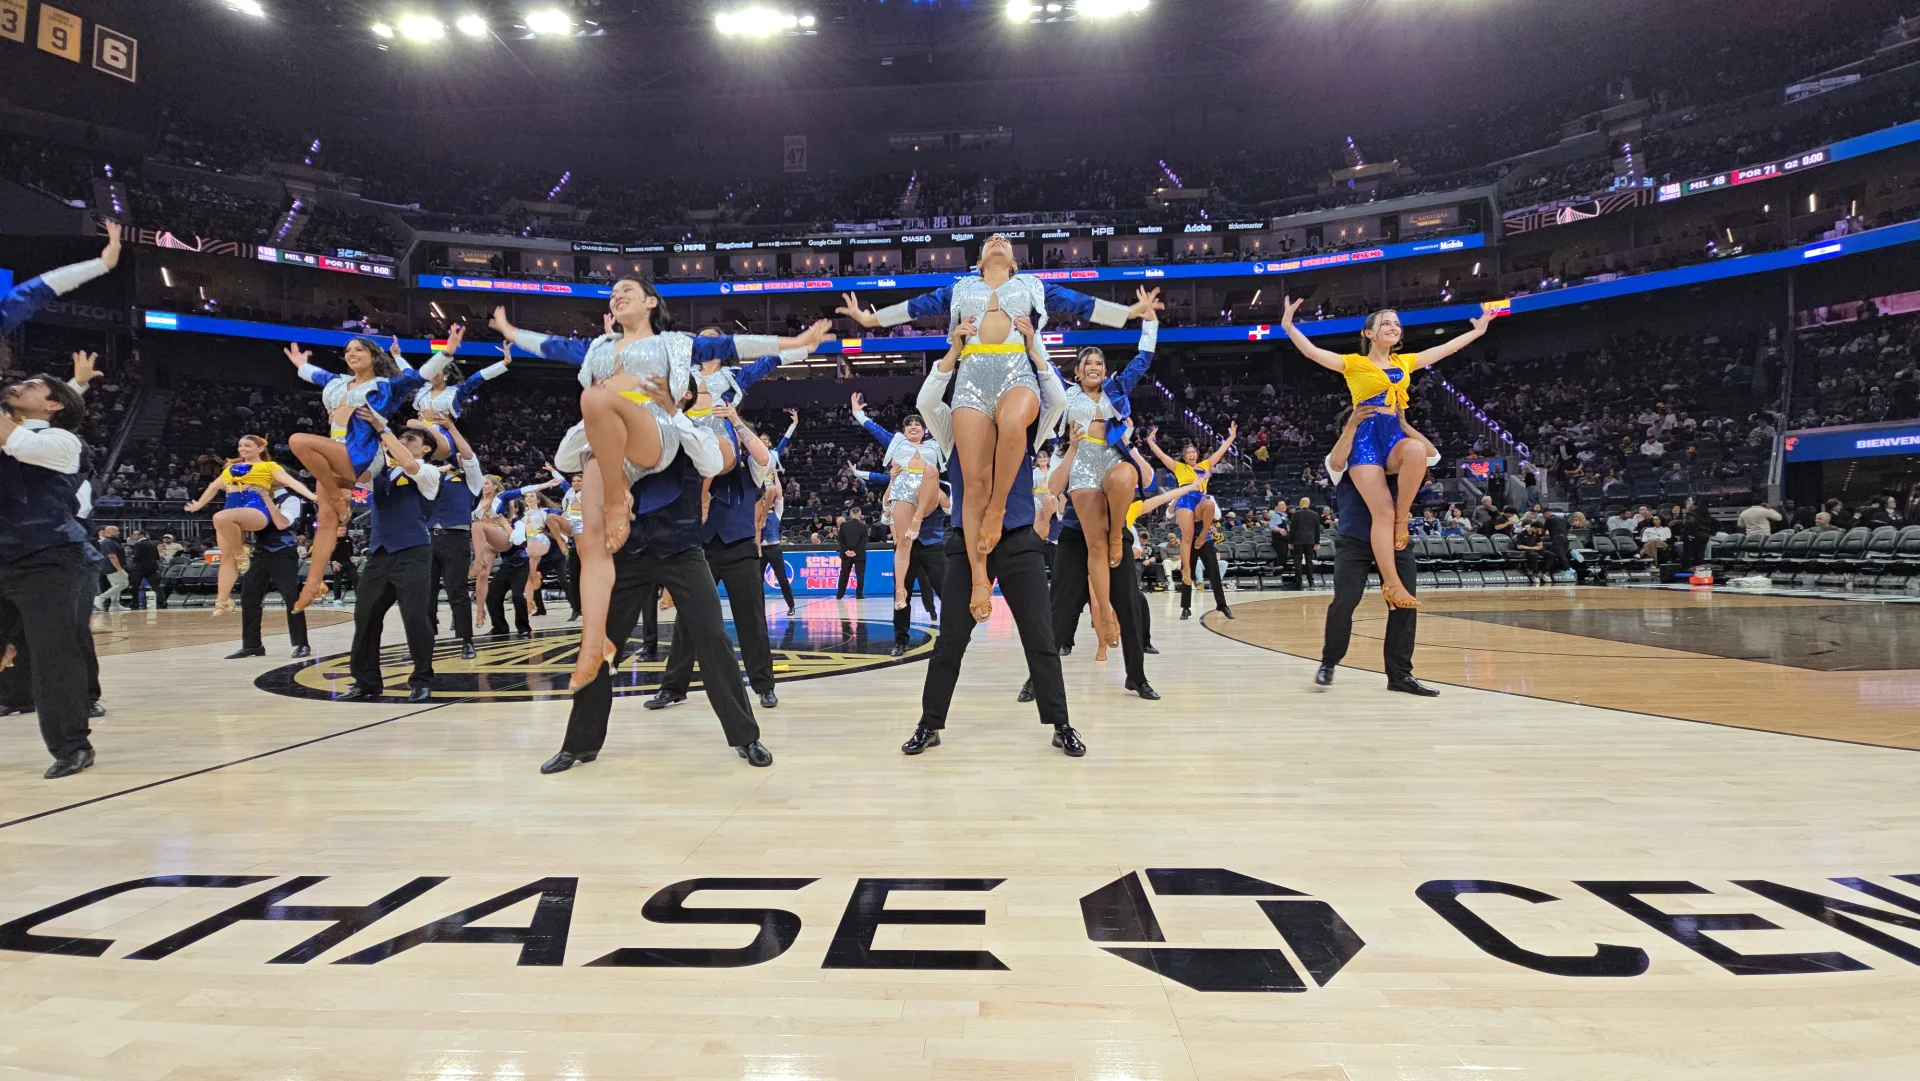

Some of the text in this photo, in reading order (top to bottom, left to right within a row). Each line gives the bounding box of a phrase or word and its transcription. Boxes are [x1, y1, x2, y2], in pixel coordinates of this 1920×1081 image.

[2, 8, 18, 33] 3
[51, 26, 68, 51] 9
[102, 37, 128, 69] 6
[787, 147, 804, 164] 47
[1739, 152, 1823, 179] POR 71 Q2 0:00
[1690, 175, 1725, 190] MIL 49
[1091, 227, 1115, 235] HPE
[1138, 225, 1163, 233] verizon
[1184, 223, 1212, 232] Adobe
[1228, 222, 1264, 230] ticketmaster
[951, 233, 974, 241] Rakuten
[1042, 231, 1070, 239] accenture
[683, 243, 706, 251] PEPSI
[716, 241, 754, 250] RingCentral
[808, 238, 842, 247] Google Cloud
[285, 253, 314, 264] MIL 49
[325, 259, 389, 275] POR 71 Q2 0:00
[41, 299, 124, 322] erizon
[1856, 436, 1920, 449] BIENVEN
[0, 874, 1920, 977] CHASE CEN
